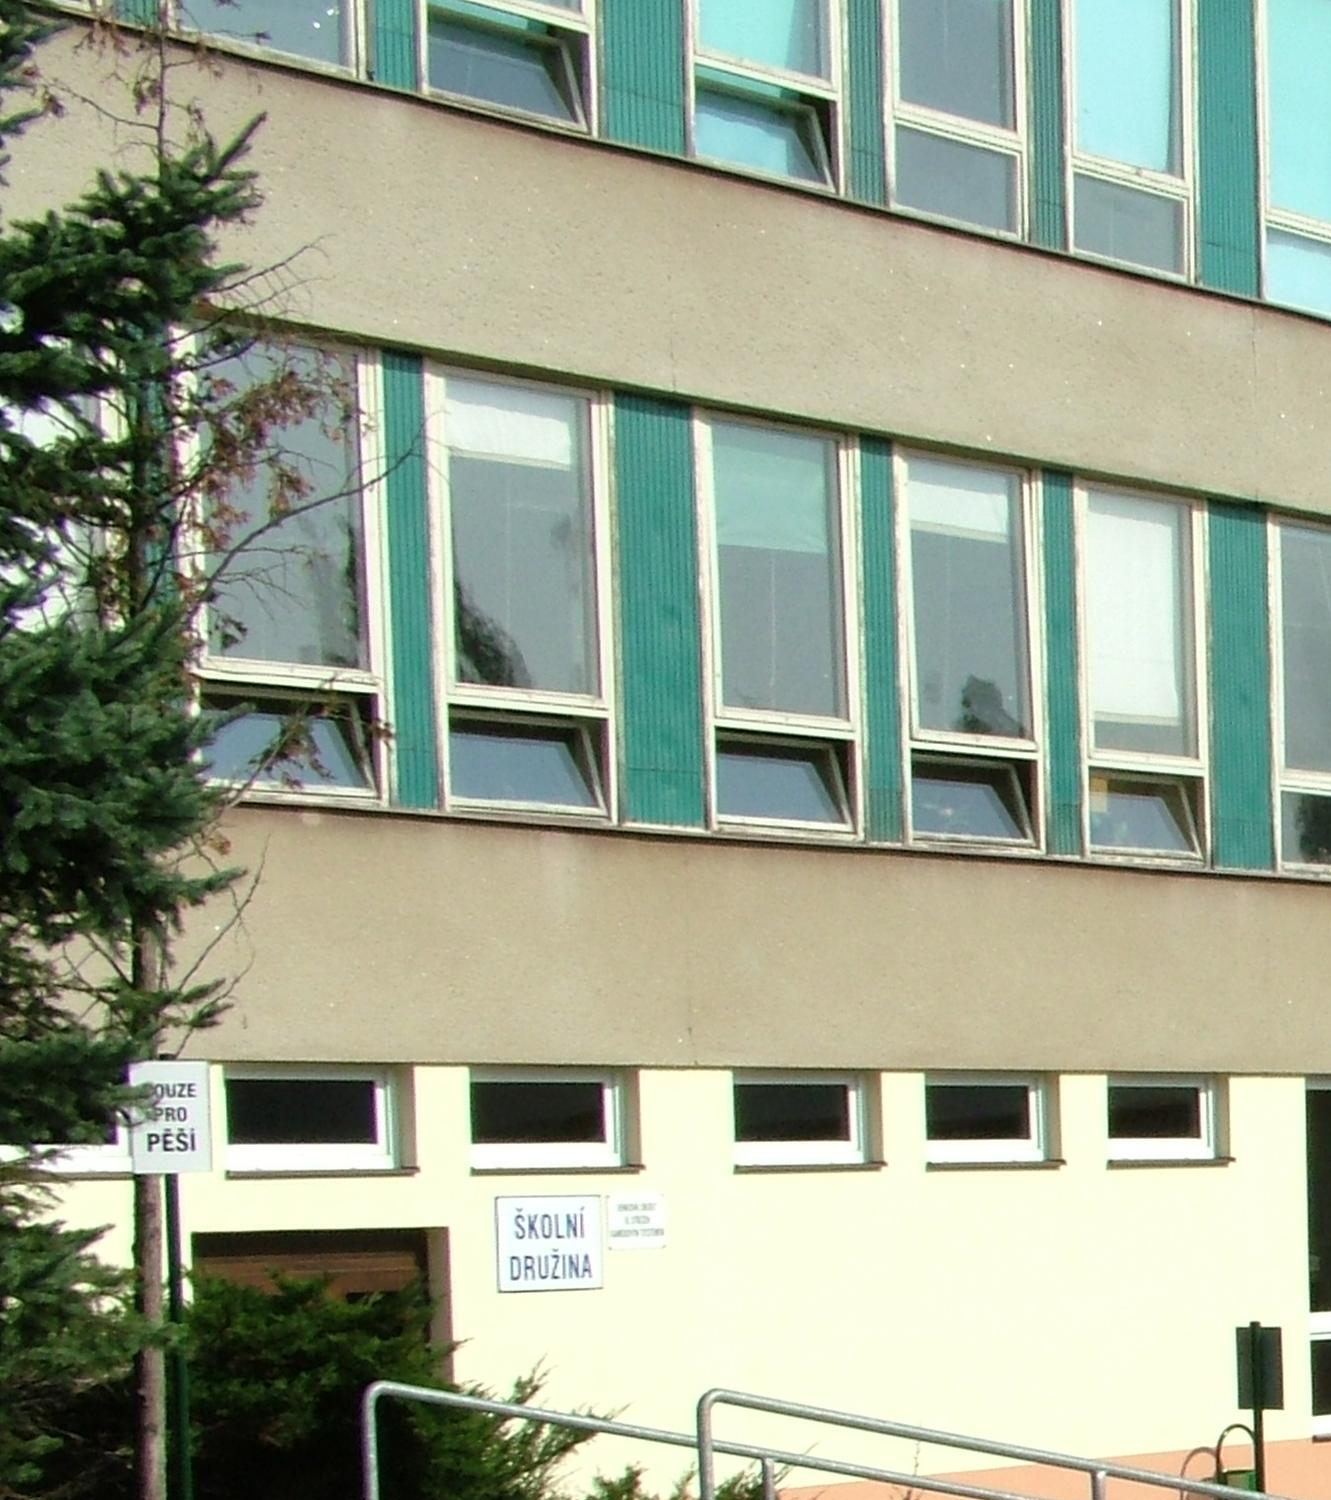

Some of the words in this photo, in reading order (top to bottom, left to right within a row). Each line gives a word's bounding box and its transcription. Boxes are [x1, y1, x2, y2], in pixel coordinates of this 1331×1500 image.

[152, 1083, 197, 1098] OUZE
[147, 1128, 196, 1152] PĚŠÍ
[514, 1206, 586, 1240] ŠKOLNÍ
[510, 1248, 593, 1281] DRUŽINA
